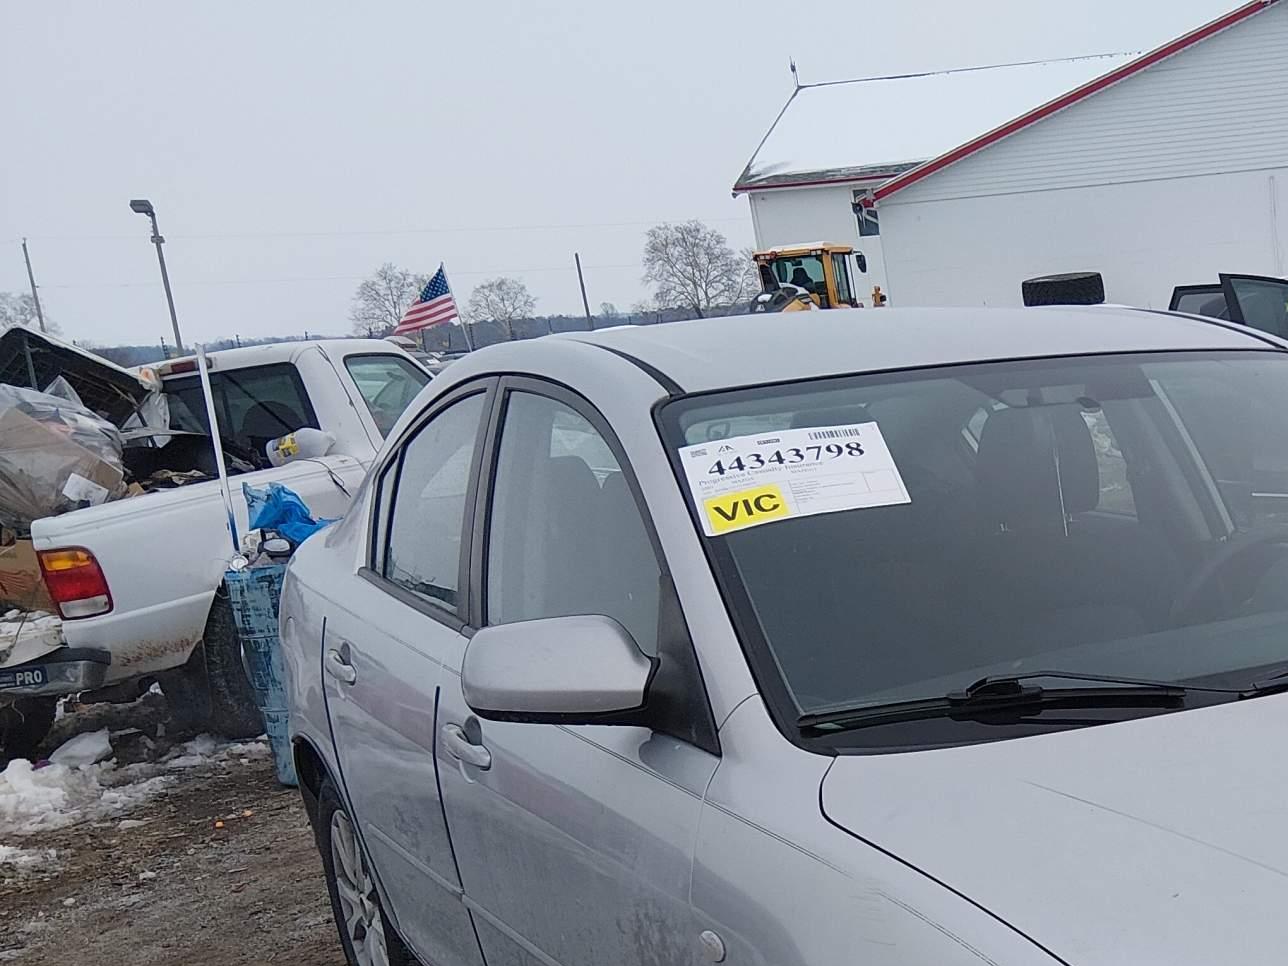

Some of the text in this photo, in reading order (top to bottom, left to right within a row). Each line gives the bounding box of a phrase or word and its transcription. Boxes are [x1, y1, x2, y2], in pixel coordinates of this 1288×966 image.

[708, 441, 865, 475] 44343798
[713, 494, 780, 522] VIC
[15, 670, 42, 685] PRO
